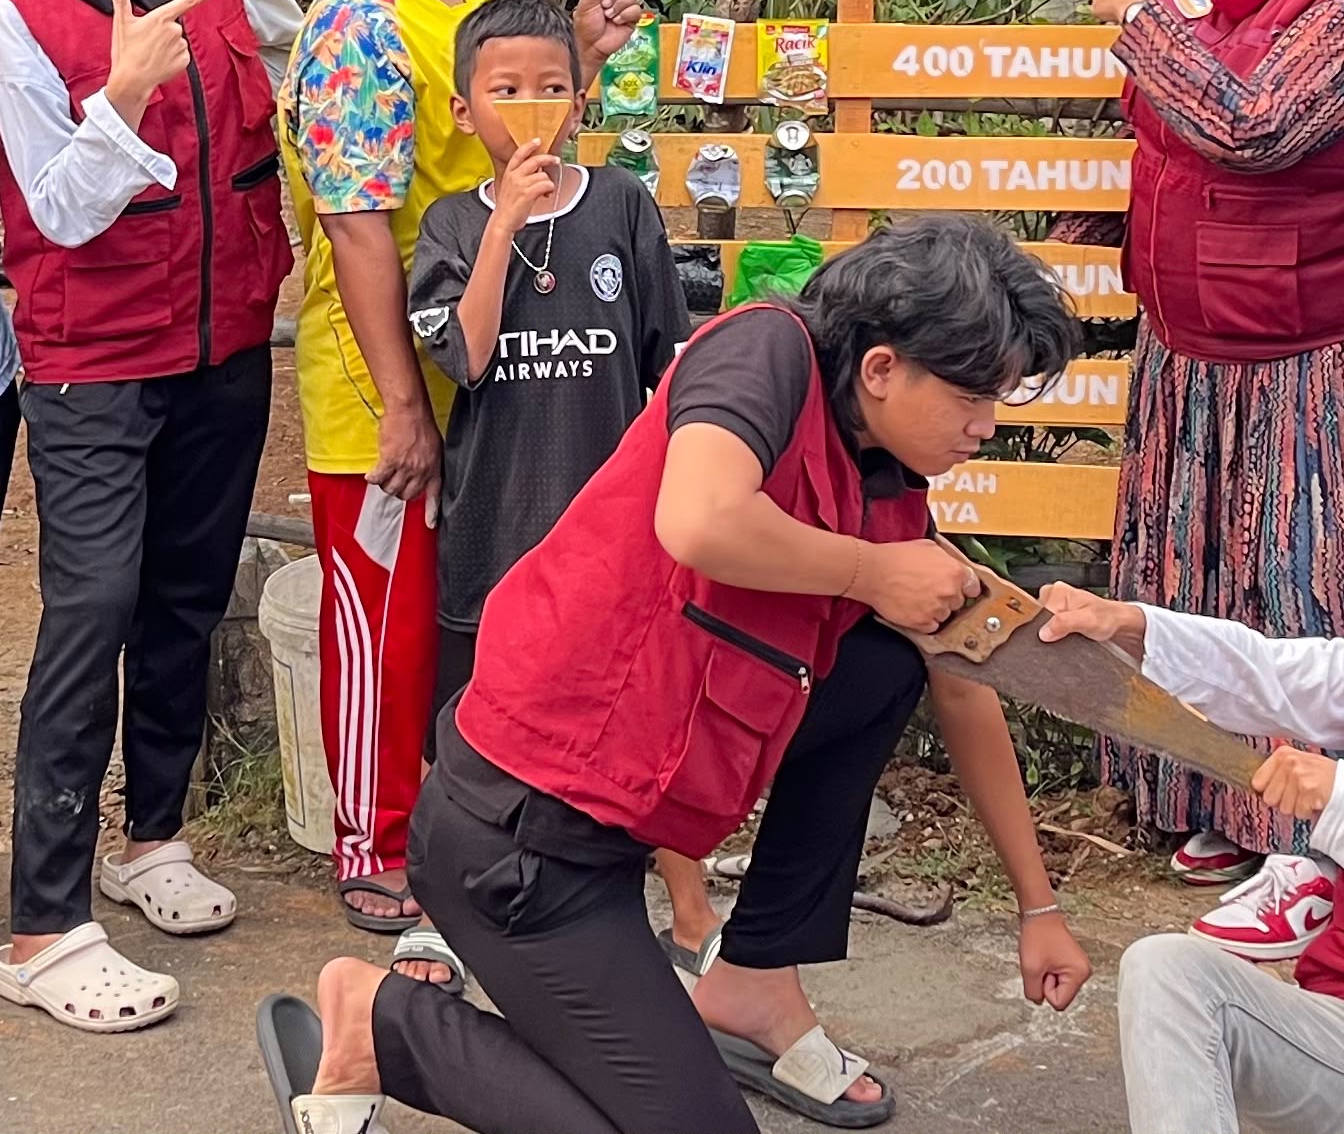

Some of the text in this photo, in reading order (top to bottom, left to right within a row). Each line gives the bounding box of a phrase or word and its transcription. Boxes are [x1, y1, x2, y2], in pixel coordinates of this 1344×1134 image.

[775, 34, 817, 53] Racik
[685, 60, 717, 75] Klin
[893, 45, 973, 78] 400
[896, 159, 1130, 191] 200 TAHUN
[498, 328, 617, 358] TIHAD
[494, 359, 593, 382] AIRWAYS
